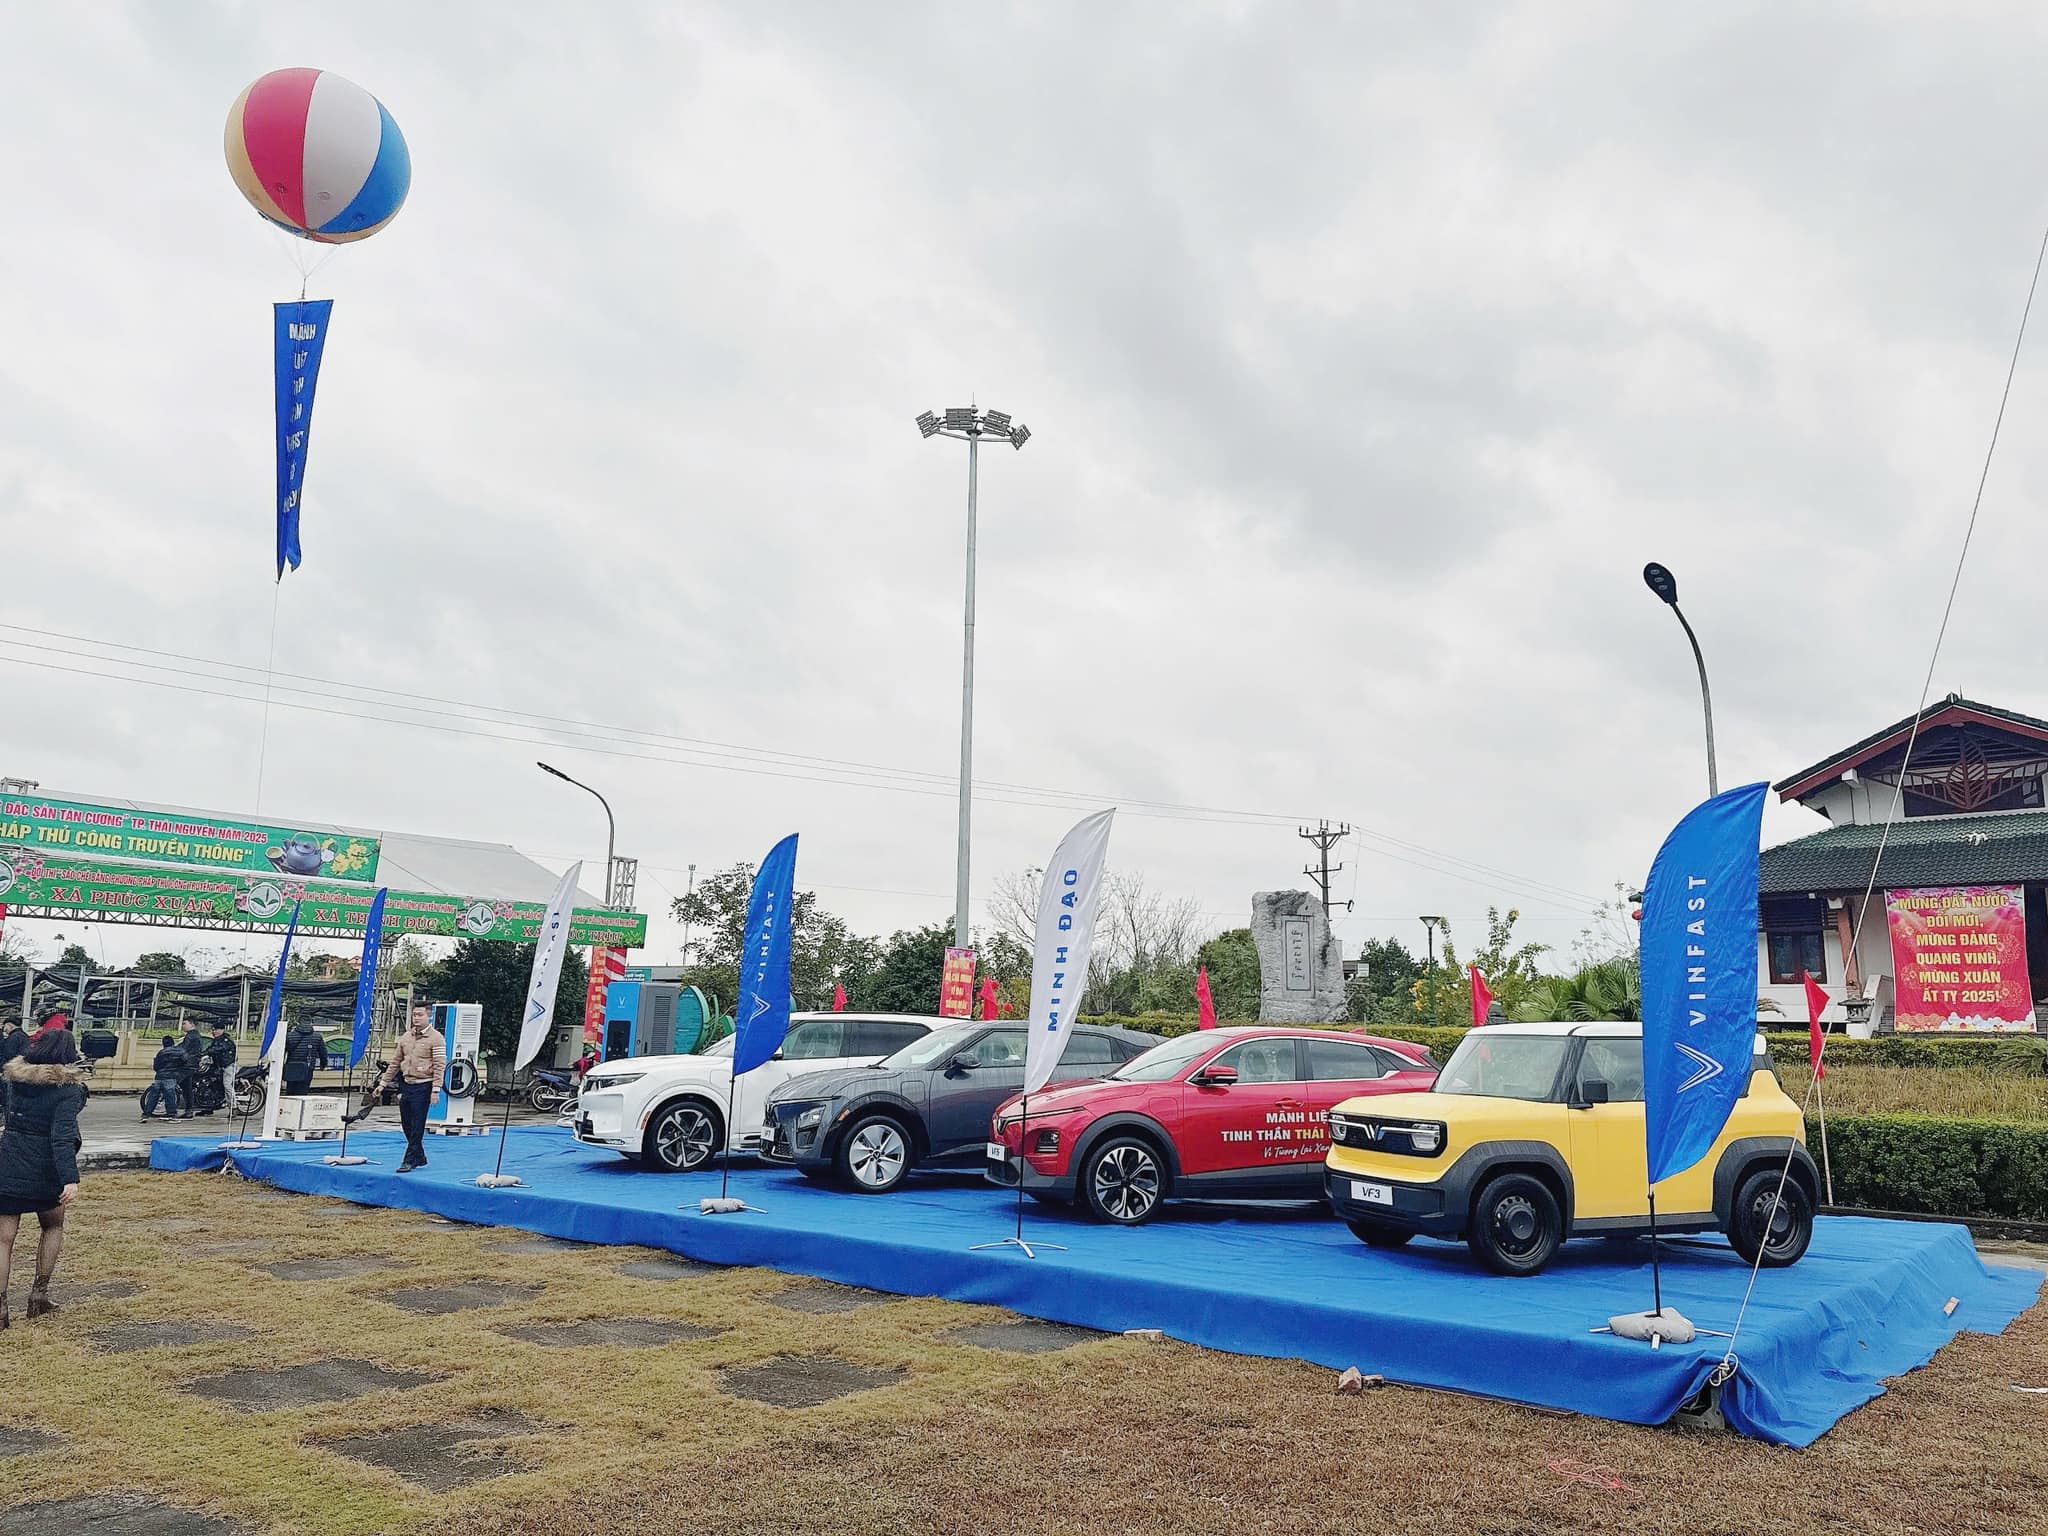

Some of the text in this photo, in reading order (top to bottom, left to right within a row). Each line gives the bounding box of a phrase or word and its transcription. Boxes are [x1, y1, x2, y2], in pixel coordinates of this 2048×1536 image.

[5, 801, 29, 818] ĐẶC
[32, 803, 57, 819] SẢN
[60, 808, 82, 822] TÂN
[149, 819, 172, 833] THÁI
[175, 824, 215, 837] NGUYÊN
[218, 828, 242, 841] NĂM
[243, 831, 267, 843] 2025
[0, 821, 31, 838] HÁP
[38, 824, 71, 843] THỦ
[75, 830, 122, 849] CÔNG
[127, 836, 189, 856] TRUYỀN
[50, 886, 214, 912] XÃ PHÚC XUÂN
[1900, 892, 2009, 910] MỪNG ĐẤT NƯỚC
[313, 908, 339, 923] XÃ
[404, 915, 438, 930] ĐỨC
[1926, 912, 1984, 928] ĐỔI MỚI,
[757, 890, 776, 982] VINFAST
[1916, 930, 1997, 946] MỪNG ĐẢNG
[1047, 869, 1079, 1032] MINH ĐẠO
[1686, 874, 1709, 1027] VINFAST
[1916, 952, 2001, 965] QUANG VINH,
[1919, 968, 2000, 984] MỪNG XUÂN
[1922, 987, 2000, 1005] ẤT TỴ 2025!
[1266, 1109, 1329, 1124] MÃNH LIỆ
[1221, 1126, 1324, 1142] TINH THẦN THÁI
[1314, 1142, 1330, 1153] Xan
[1362, 1186, 1380, 1199] VF3
